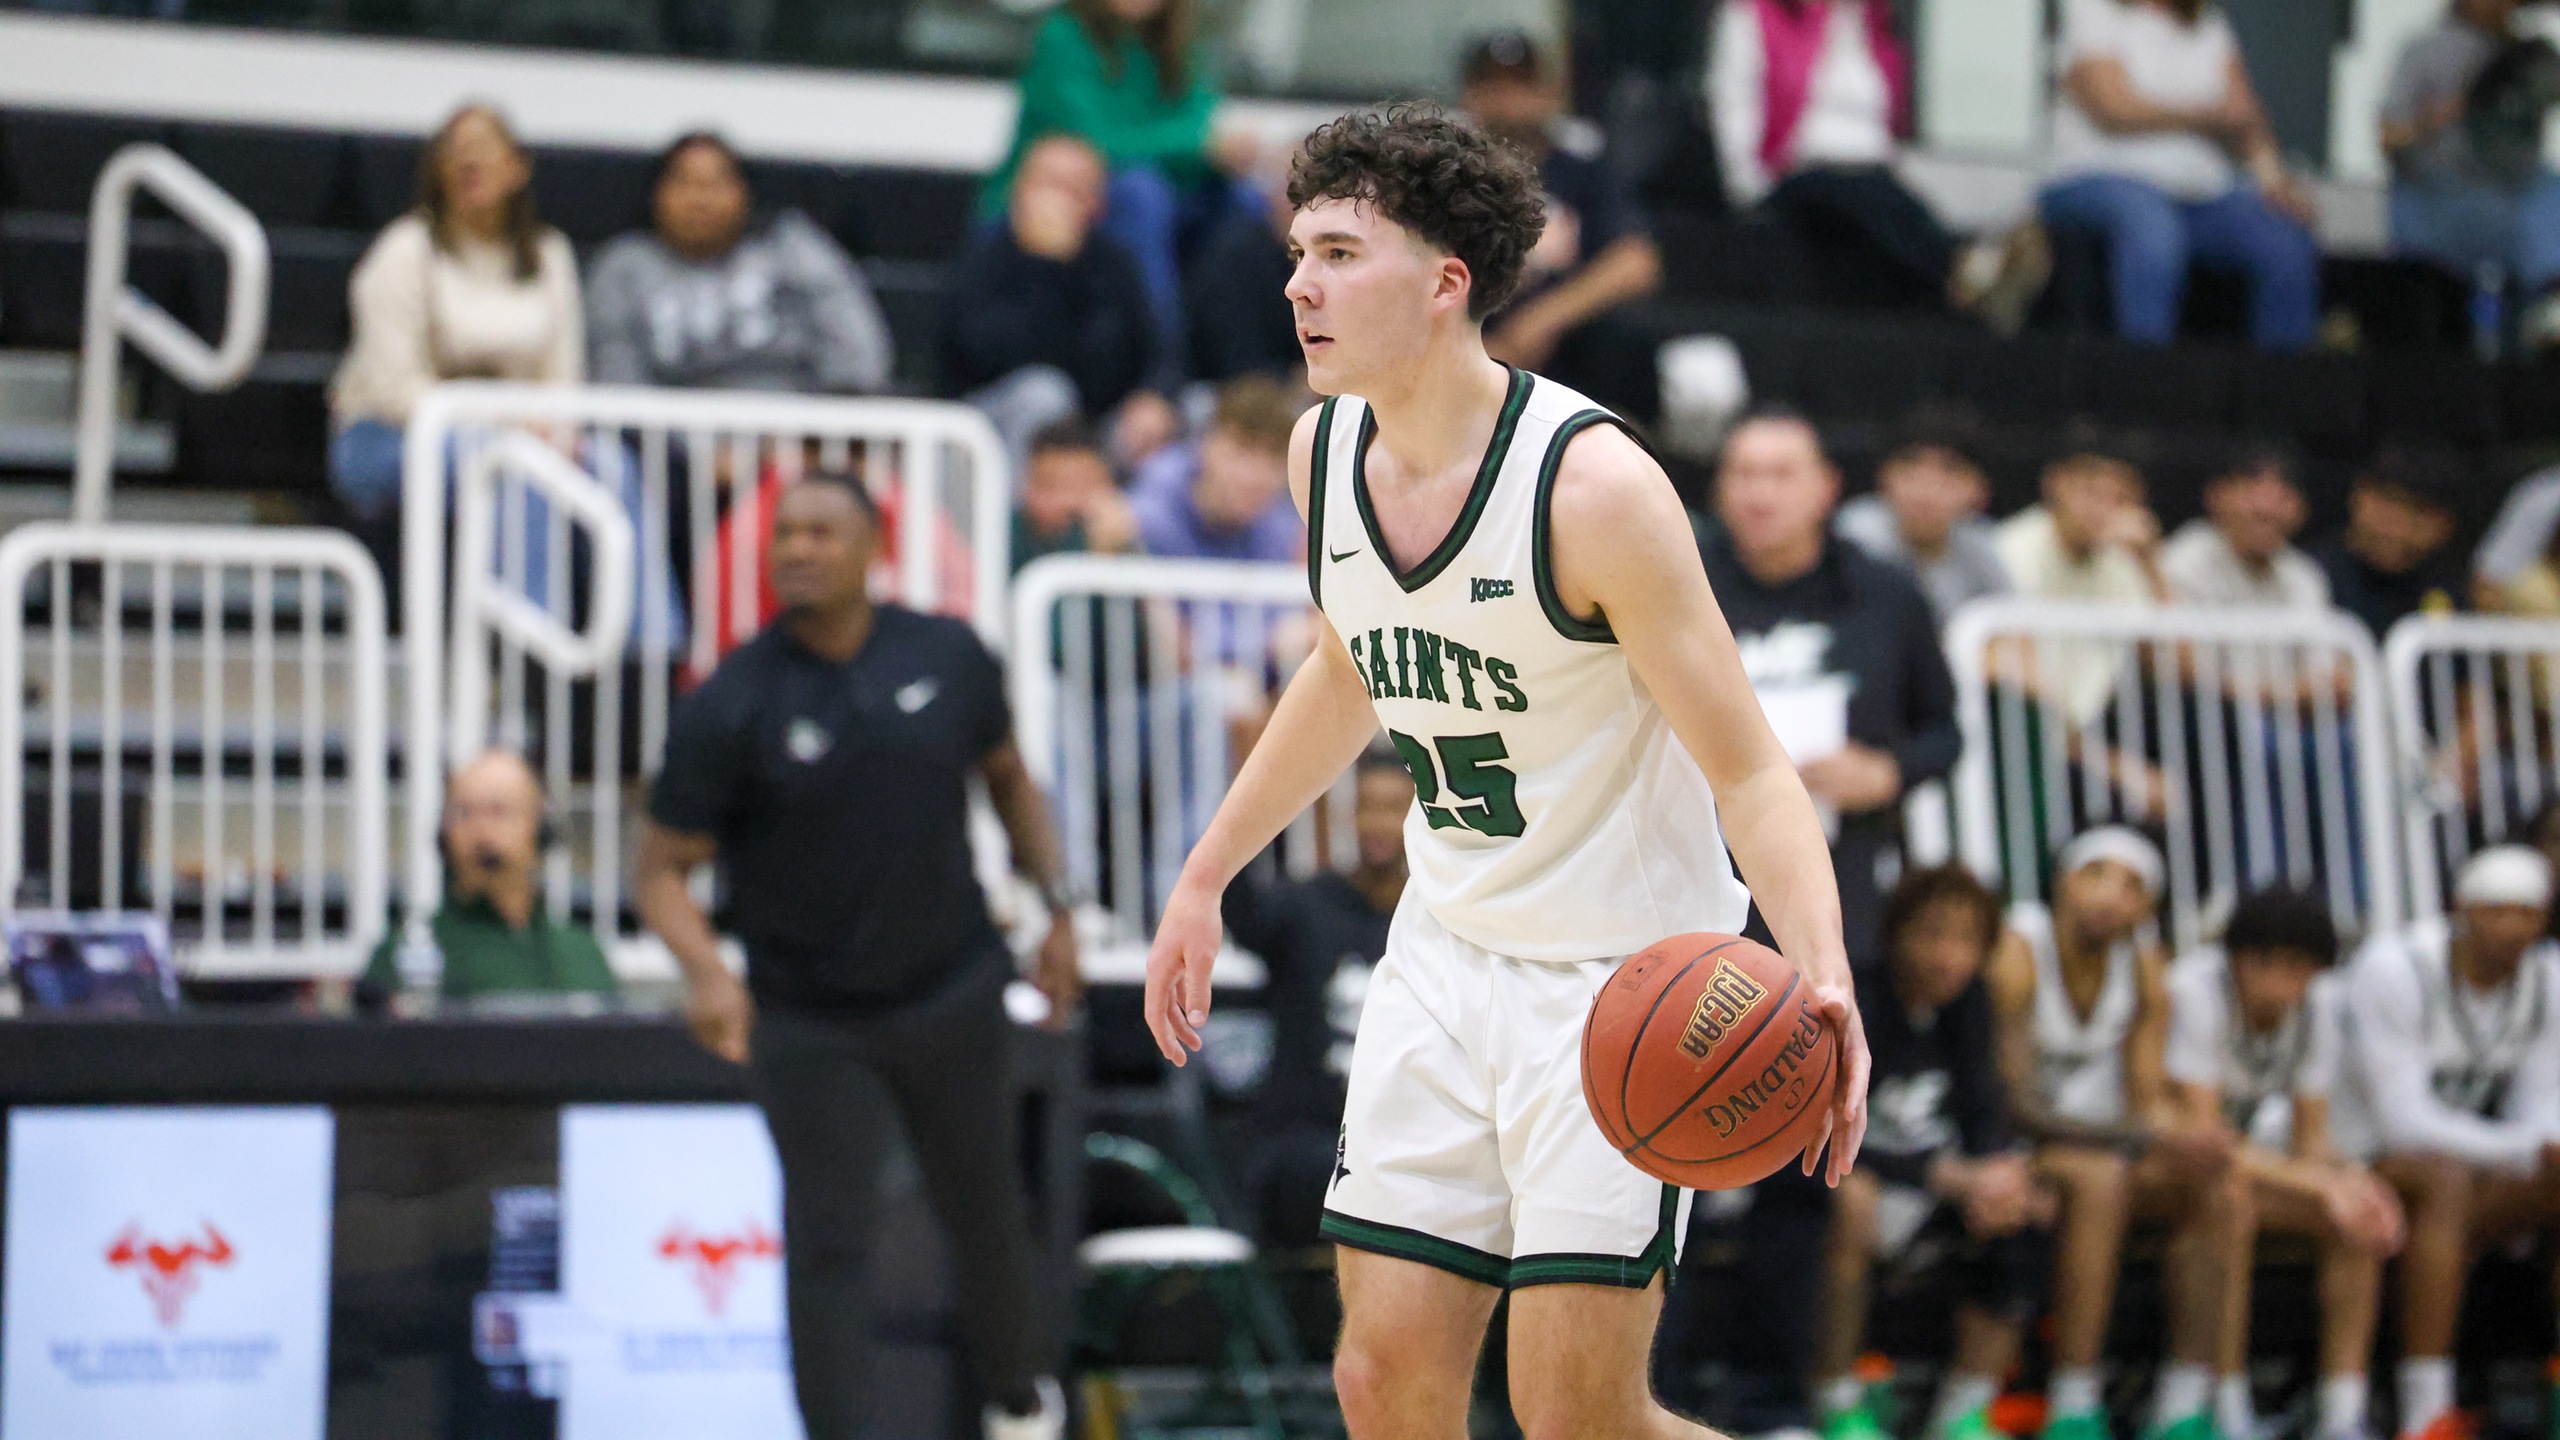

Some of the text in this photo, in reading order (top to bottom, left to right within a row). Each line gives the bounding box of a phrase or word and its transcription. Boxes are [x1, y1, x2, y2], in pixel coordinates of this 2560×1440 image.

[1470, 577, 1514, 603] KJCCC
[1350, 626, 1528, 712] SAINTS
[1389, 728, 1528, 838] 25
[1678, 958, 1767, 1063] NJCAA
